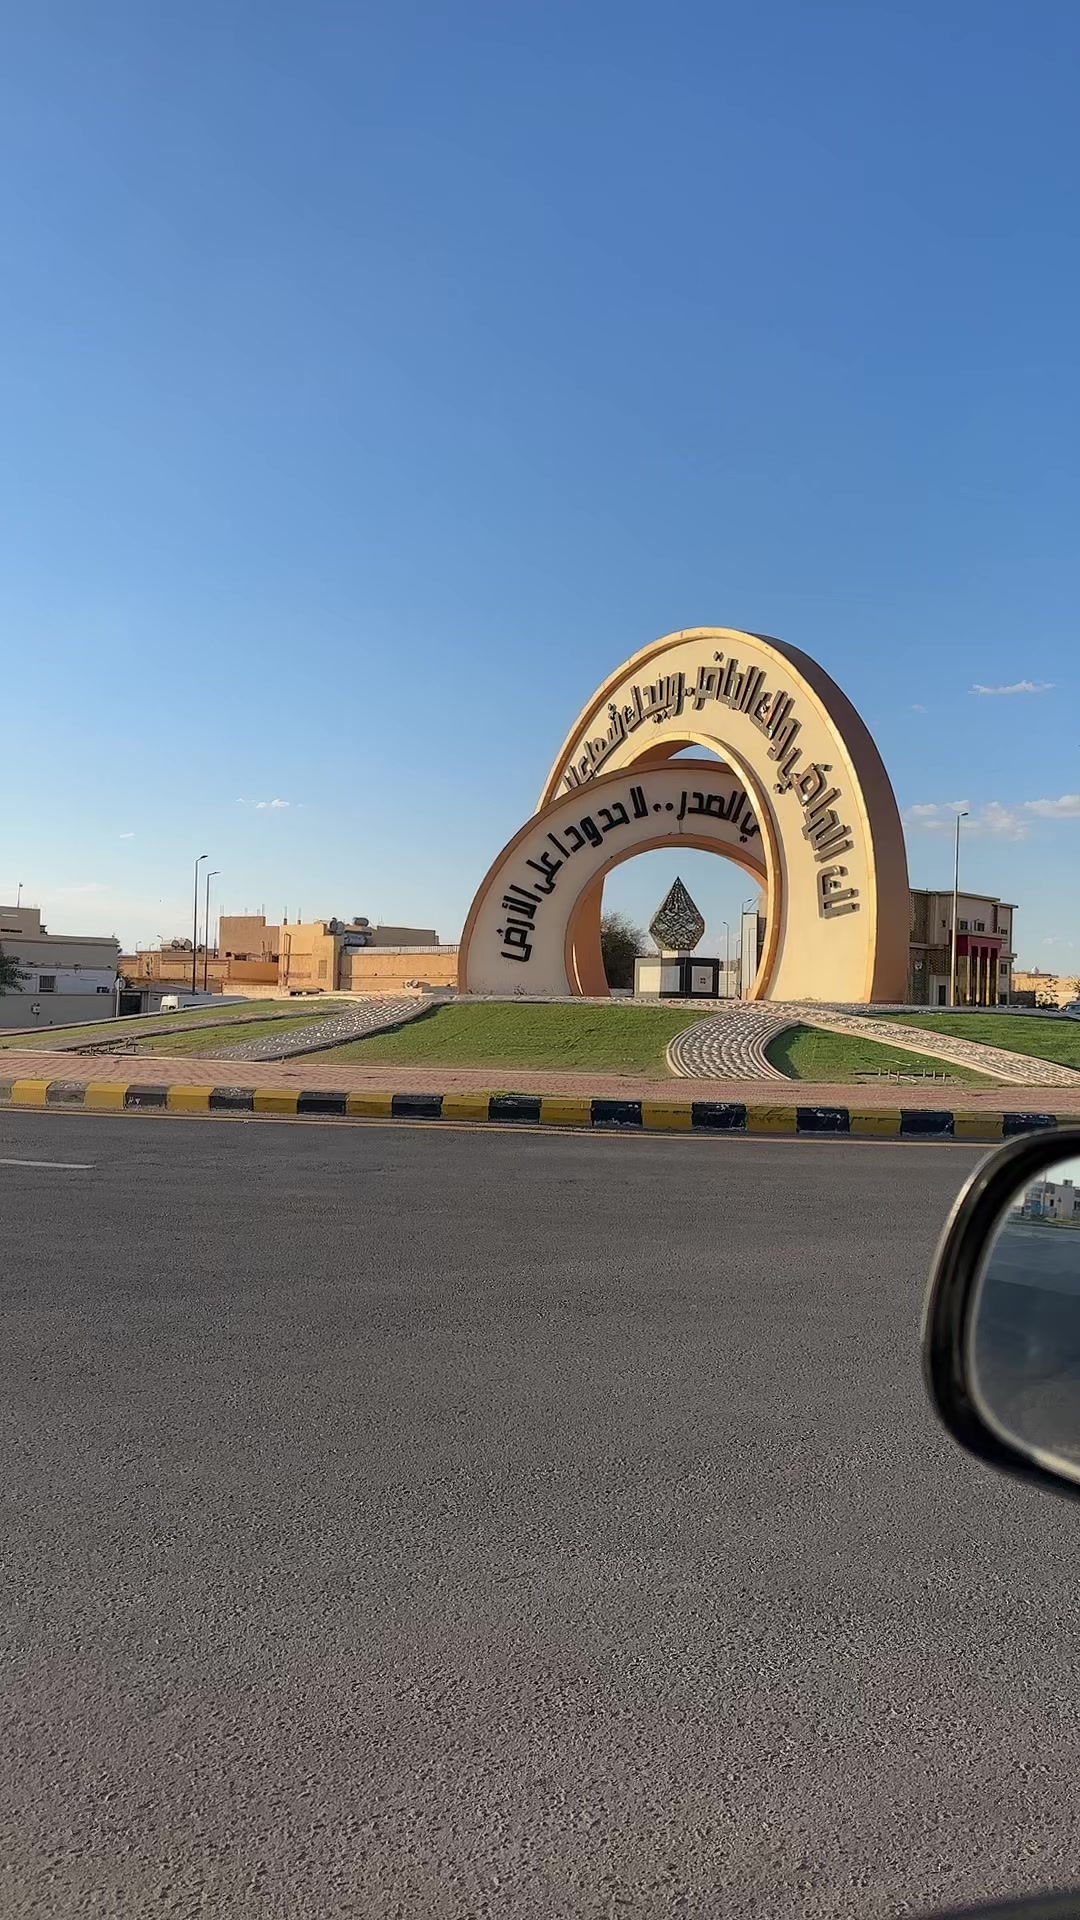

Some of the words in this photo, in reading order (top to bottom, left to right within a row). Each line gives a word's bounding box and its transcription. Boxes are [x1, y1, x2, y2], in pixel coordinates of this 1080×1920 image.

[630, 786, 649, 818] لا
[773, 747, 854, 863] الماضي
[526, 851, 564, 894] على
[817, 865, 860, 919] لك
[496, 884, 543, 963] الأرض
